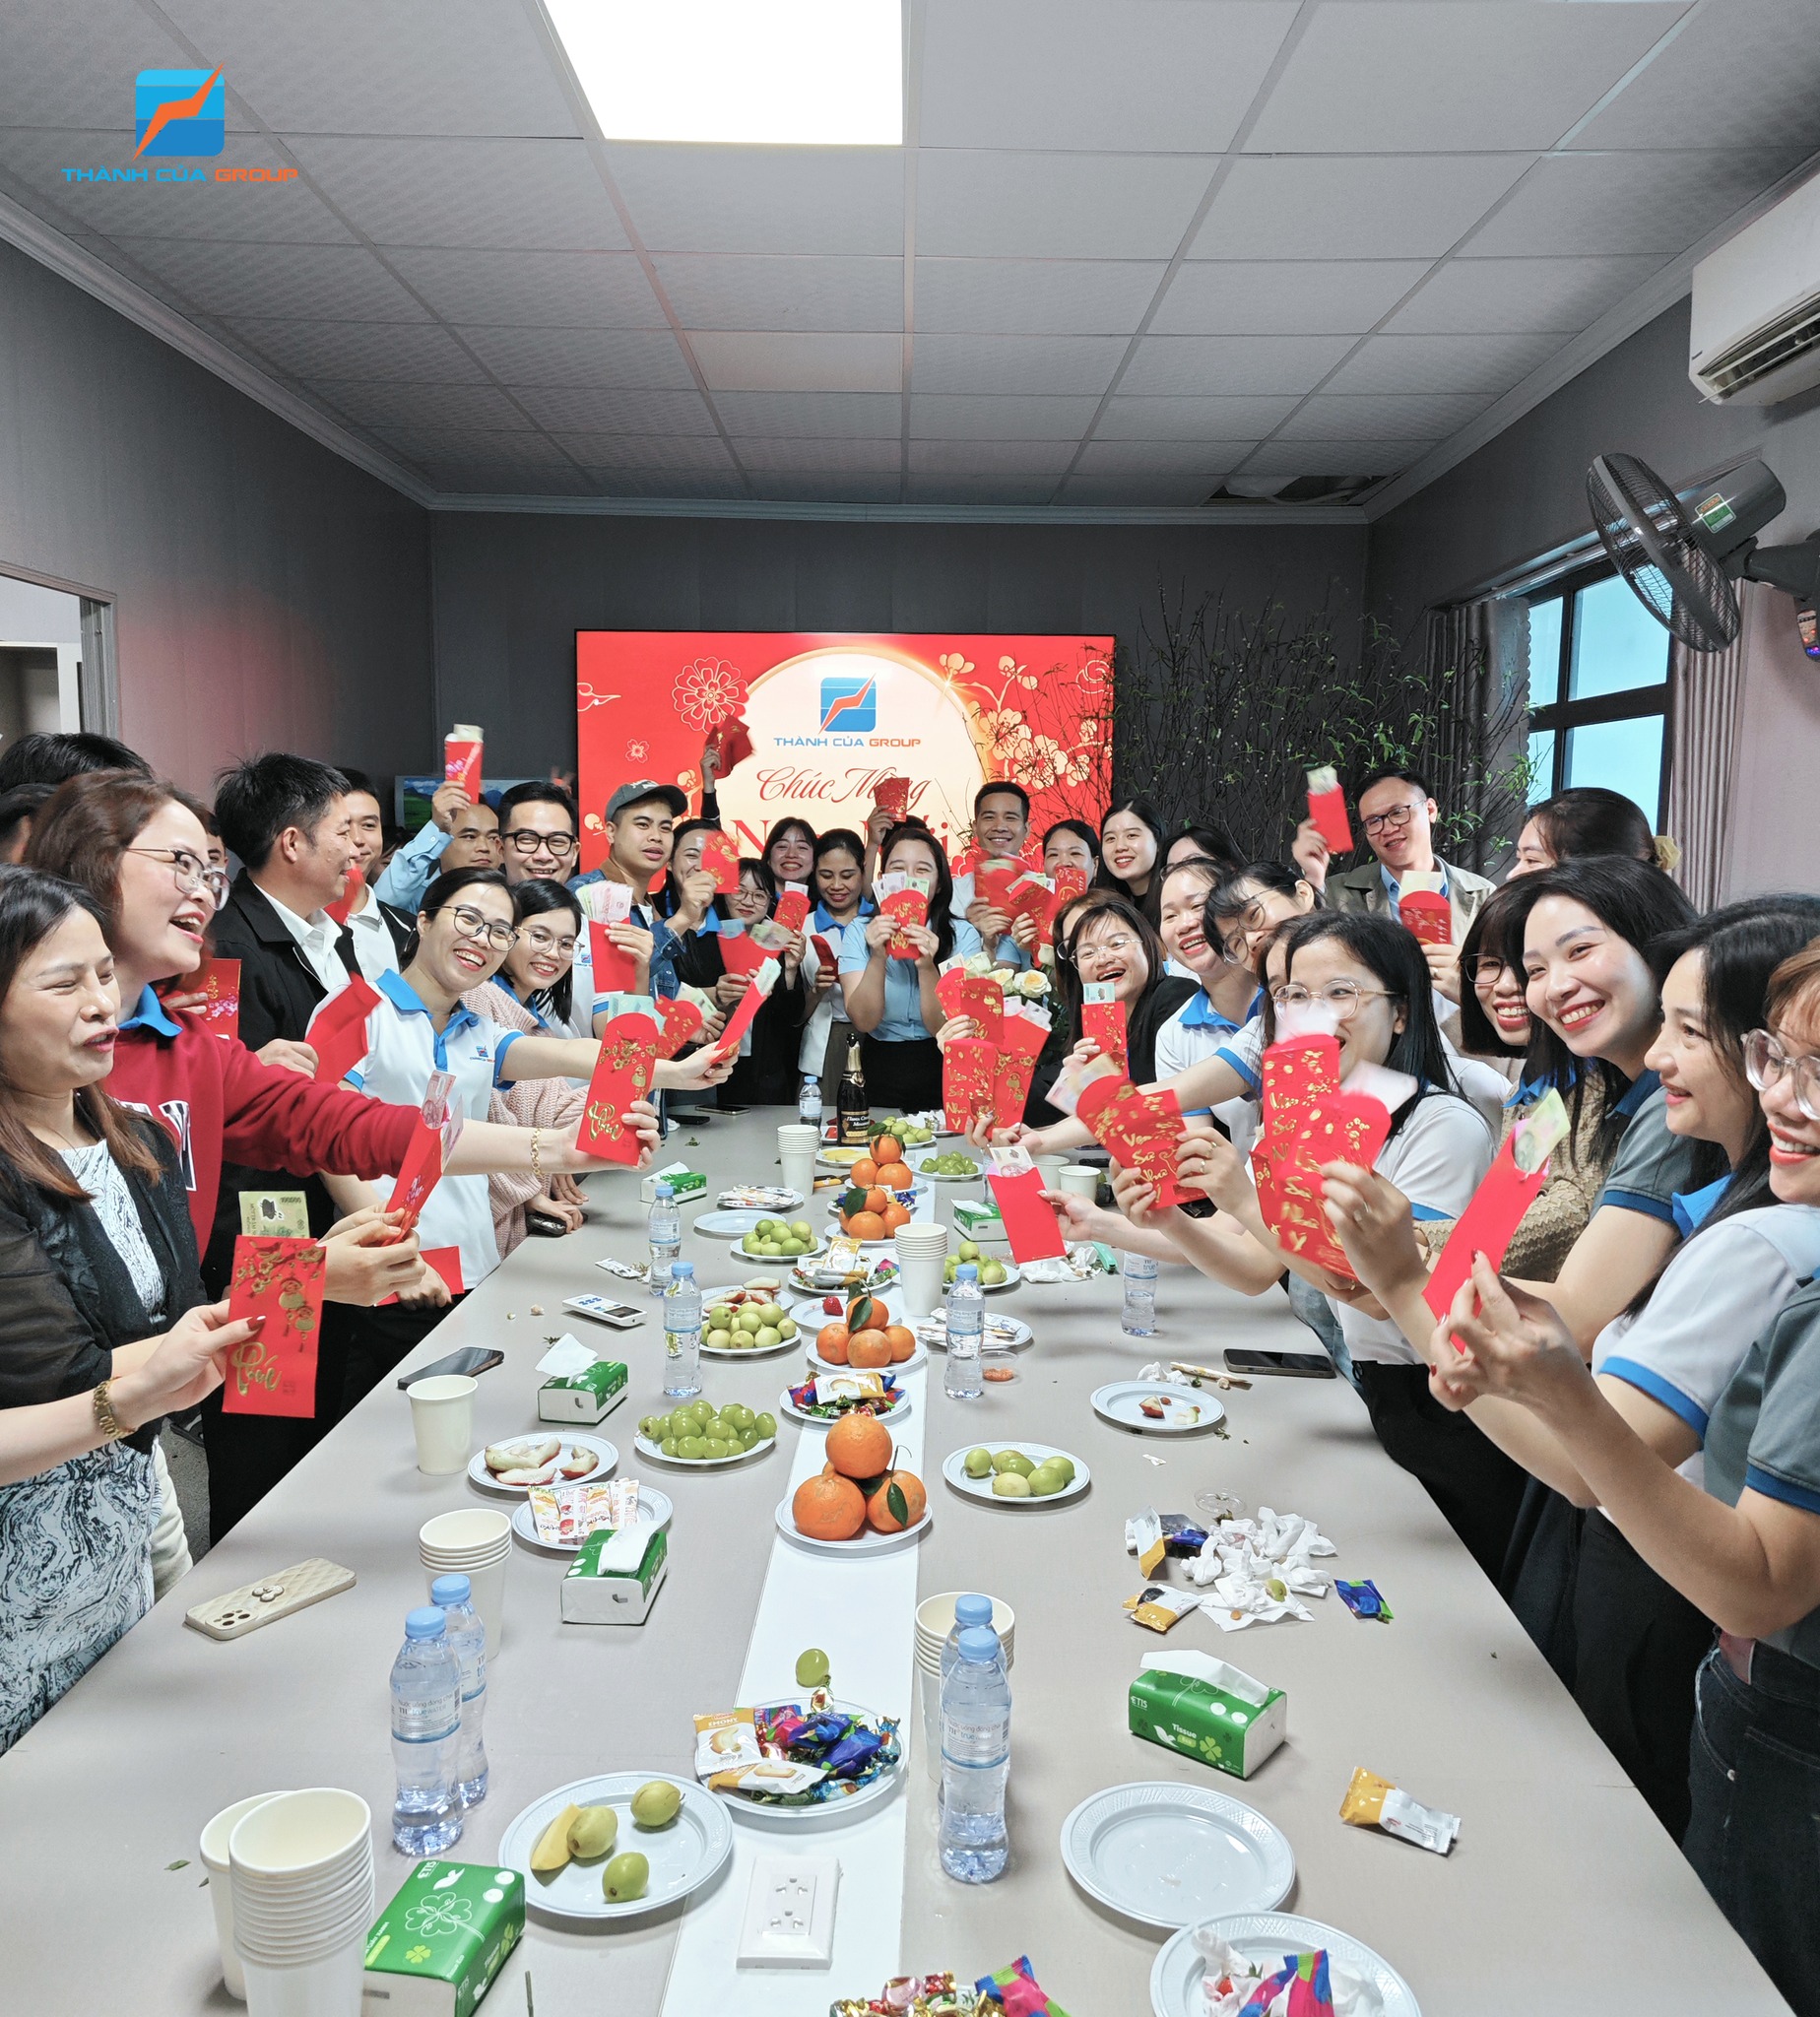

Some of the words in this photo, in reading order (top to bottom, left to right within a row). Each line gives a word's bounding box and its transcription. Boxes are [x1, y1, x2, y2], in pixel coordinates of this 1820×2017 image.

[773, 737, 828, 748] THÀNH
[832, 735, 865, 748] CỦA
[869, 738, 921, 748] GROUP
[756, 766, 835, 802] Chúc
[1171, 1723, 1198, 1739] Tissue
